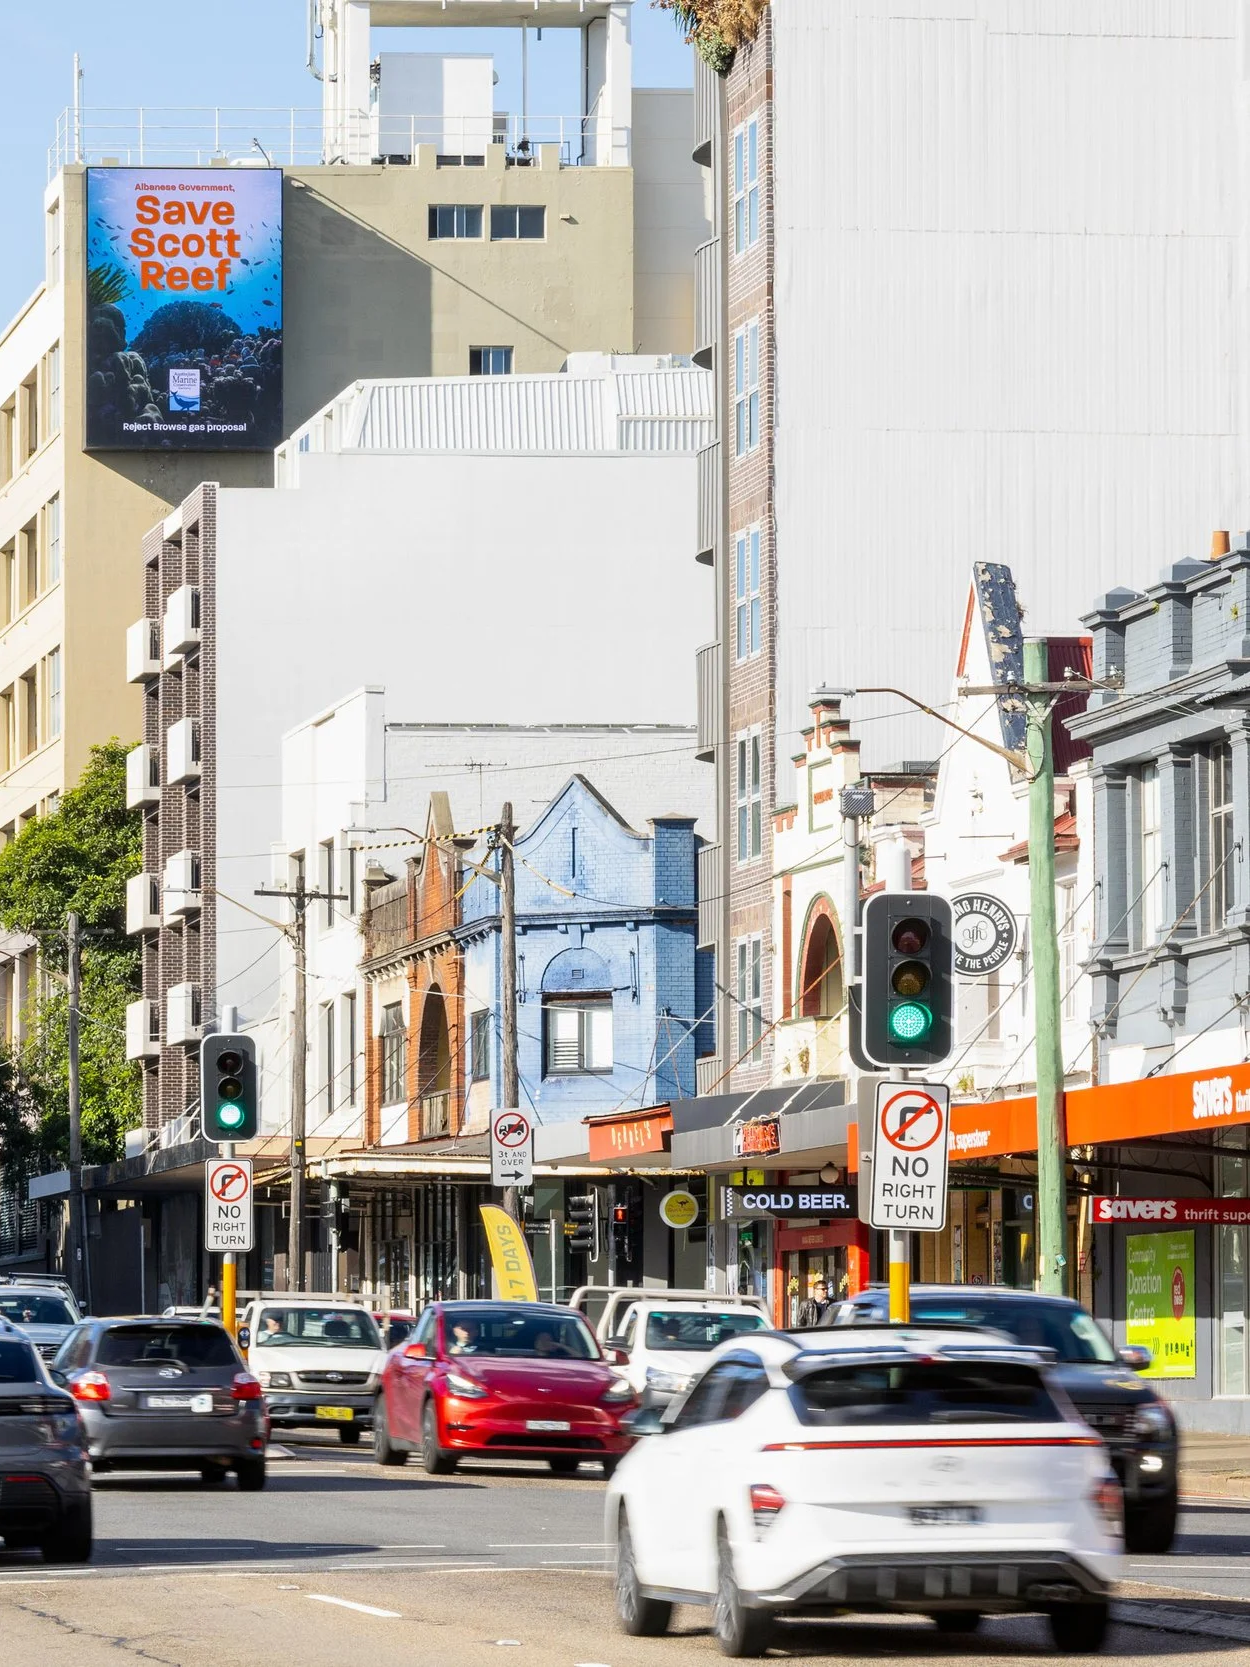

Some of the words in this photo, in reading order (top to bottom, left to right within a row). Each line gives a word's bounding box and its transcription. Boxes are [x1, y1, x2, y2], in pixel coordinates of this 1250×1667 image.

[134, 183, 176, 191] Albanese
[135, 194, 235, 226] Save
[130, 227, 241, 258] Scott
[140, 259, 231, 291] Reef
[172, 375, 198, 384] Marine
[123, 422, 151, 432] Reject
[153, 423, 187, 431] Browse
[189, 424, 205, 433] gas
[207, 423, 247, 433] proposal
[972, 898, 1010, 931] HENRYS
[965, 958, 982, 969] THE
[982, 940, 1009, 967] PEOPLE
[1192, 1075, 1233, 1119] savers
[498, 1150, 508, 1158] 3t
[891, 1155, 930, 1178] NO
[882, 1182, 936, 1199] RIGHT
[742, 1193, 794, 1210] COLD
[798, 1194, 850, 1210] BEER.
[1099, 1199, 1177, 1220] savers
[1184, 1208, 1219, 1221] thrift
[218, 1205, 241, 1219] NO
[883, 1204, 935, 1220] TURN
[212, 1222, 246, 1232] RIGHT
[213, 1235, 246, 1245] TURN
[496, 1225, 522, 1272] DAYS
[509, 1279, 525, 1289] 7
[1128, 1268, 1162, 1295] Donation
[1128, 1300, 1155, 1327] Centre
